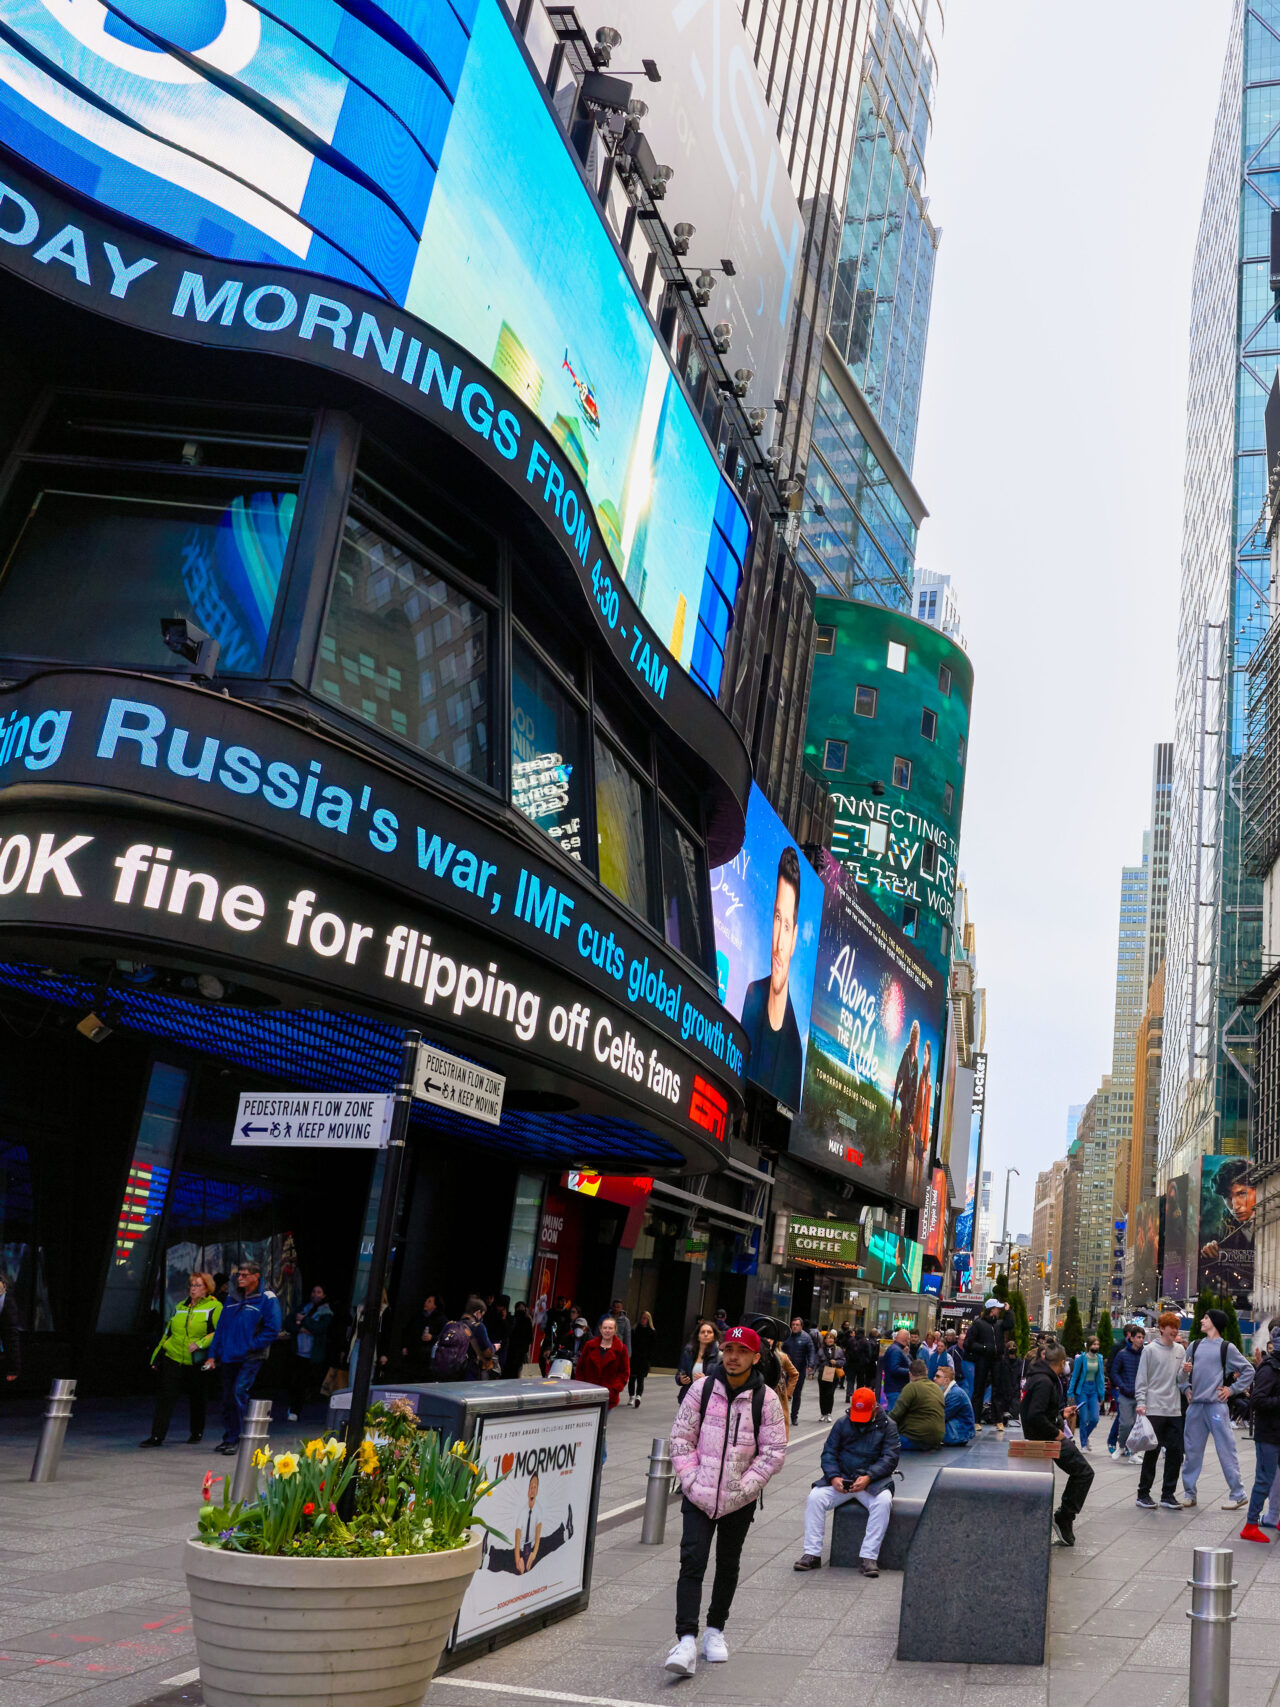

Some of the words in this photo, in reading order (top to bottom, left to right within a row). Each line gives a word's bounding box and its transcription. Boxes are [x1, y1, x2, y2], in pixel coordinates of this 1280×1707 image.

[172, 271, 521, 460] MORNINGS
[526, 440, 591, 567] FROM
[591, 558, 619, 630] 4:30
[630, 625, 669, 700] 7AM
[97, 698, 399, 853] Russia's
[417, 826, 501, 915] war,
[514, 868, 575, 940] IMF
[577, 922, 625, 981] cuts
[627, 956, 682, 1022] global
[681, 1002, 725, 1060] growth
[725, 1032, 744, 1077] fore
[114, 844, 265, 932] fine
[286, 890, 373, 964] for
[385, 925, 541, 1041] flipping
[549, 1002, 591, 1052] off
[594, 1016, 644, 1082] Celts
[647, 1048, 682, 1104] fans
[689, 1074, 728, 1143] ESPN
[828, 945, 876, 1042] Along
[840, 1007, 853, 1031] FOR
[837, 1027, 850, 1049] THE
[848, 1018, 880, 1086] Ride
[426, 1054, 466, 1083] PEDESTRIAN
[467, 1069, 485, 1088] FLOW
[484, 1076, 501, 1097] ZONE
[816, 1068, 842, 1091] TOMORROW
[843, 1085, 859, 1101] BEGINS
[859, 1095, 878, 1113] TONIGHT
[973, 1056, 986, 1101] Locker
[243, 1100, 309, 1117] PEDESTRIAN
[311, 1100, 341, 1117] FLOW
[344, 1101, 375, 1117] ZONE
[458, 1088, 475, 1108] KEEP
[474, 1094, 499, 1117] MOVING
[297, 1122, 324, 1139] KEEP
[327, 1122, 371, 1140] MOVING
[828, 1140, 839, 1156] MAY
[788, 1223, 857, 1242] STARBUCKS
[796, 1238, 842, 1253] COFFEE
